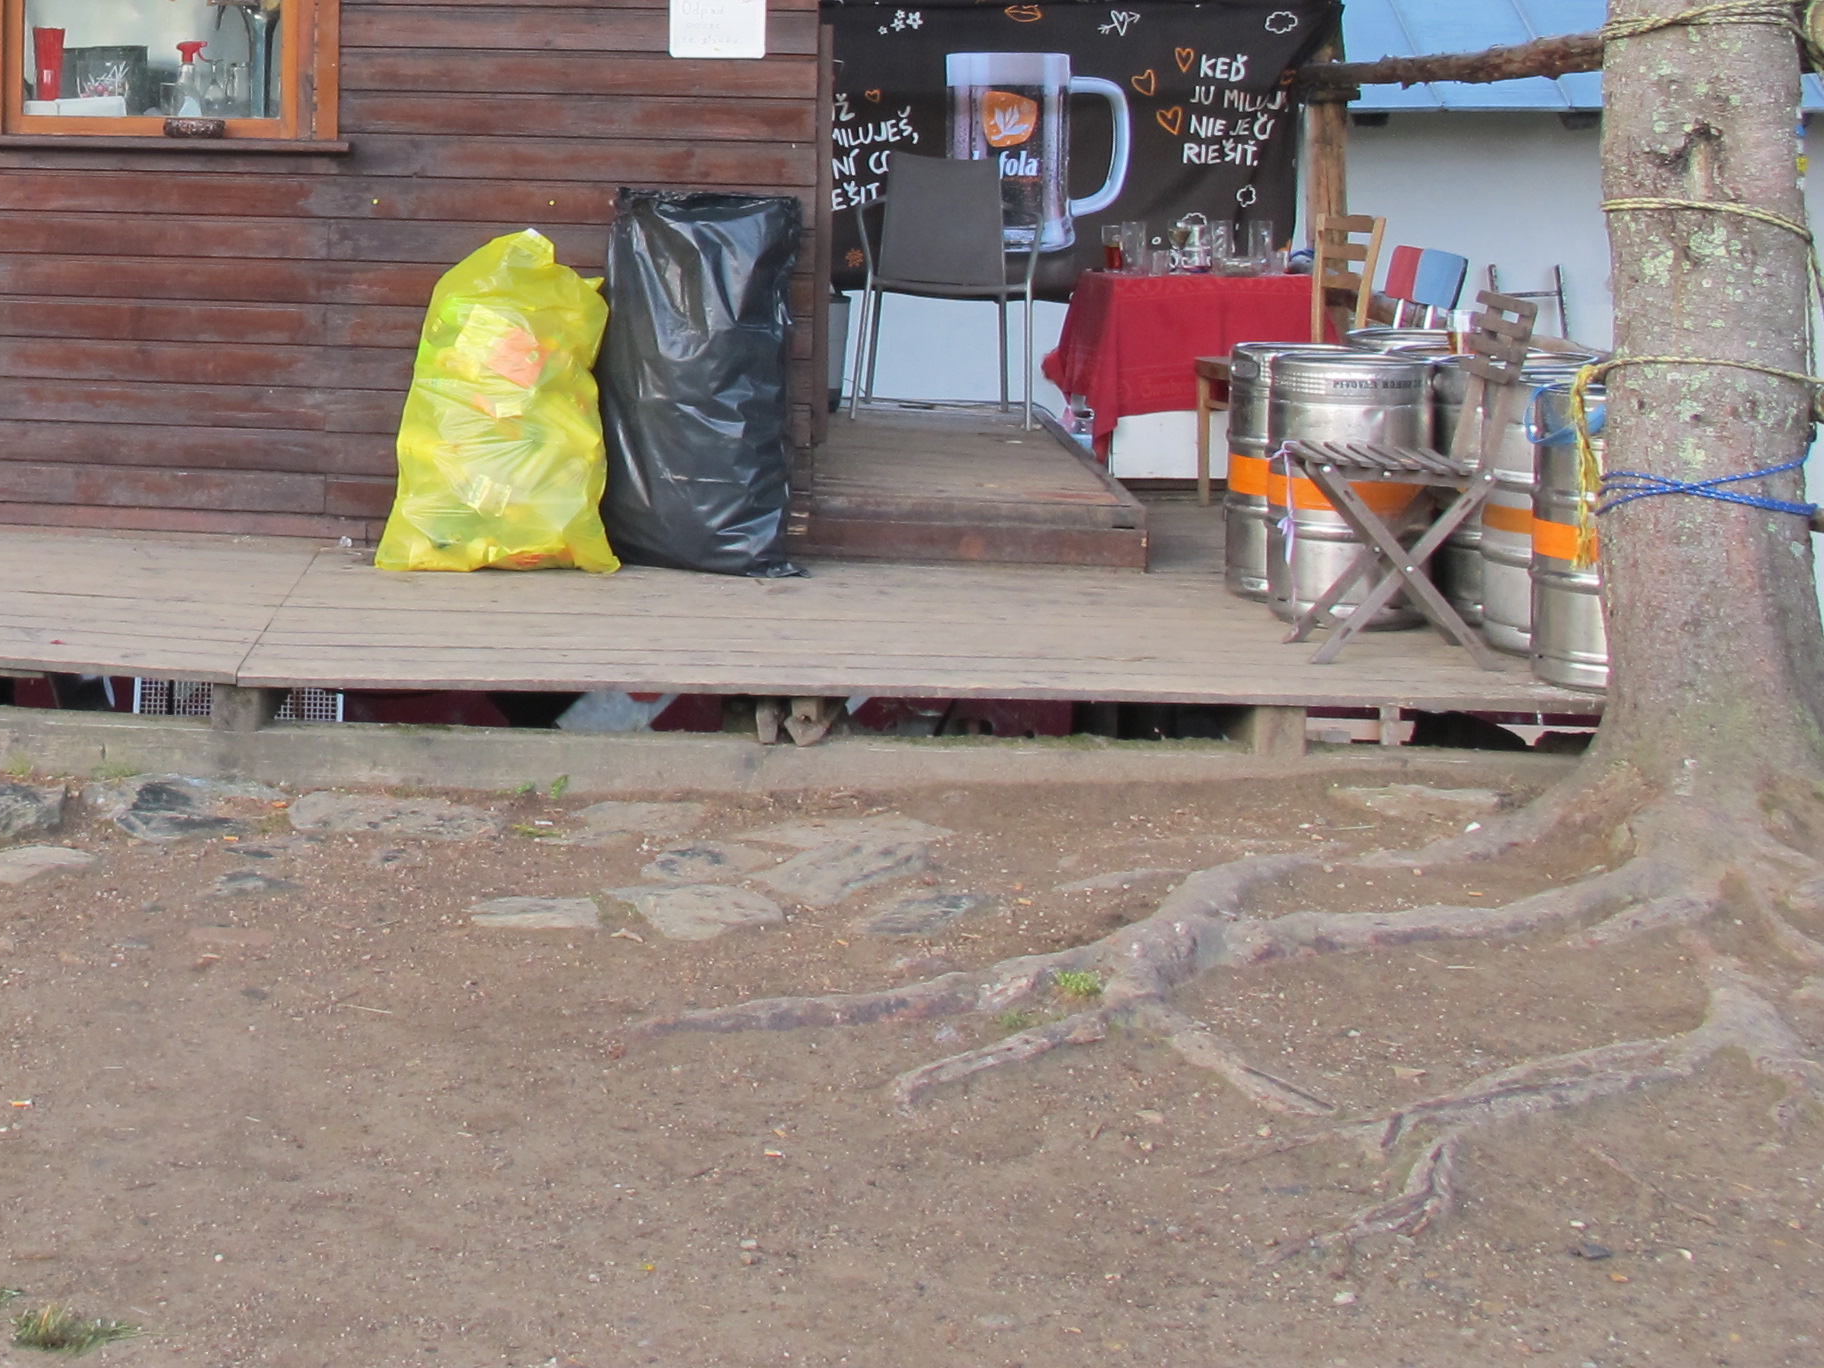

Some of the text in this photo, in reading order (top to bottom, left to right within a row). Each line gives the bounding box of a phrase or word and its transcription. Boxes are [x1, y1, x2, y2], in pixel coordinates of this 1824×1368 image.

[1200, 53, 1248, 82] KEĎ
[1189, 85, 1288, 113] JU MILUJ
[1189, 114, 1227, 139] NIE
[1229, 118, 1251, 136] JE
[831, 148, 860, 180] NÍ
[972, 150, 1038, 180] fola
[1183, 138, 1258, 166] RIEŠIŤ.
[831, 180, 880, 212] EŠIT
